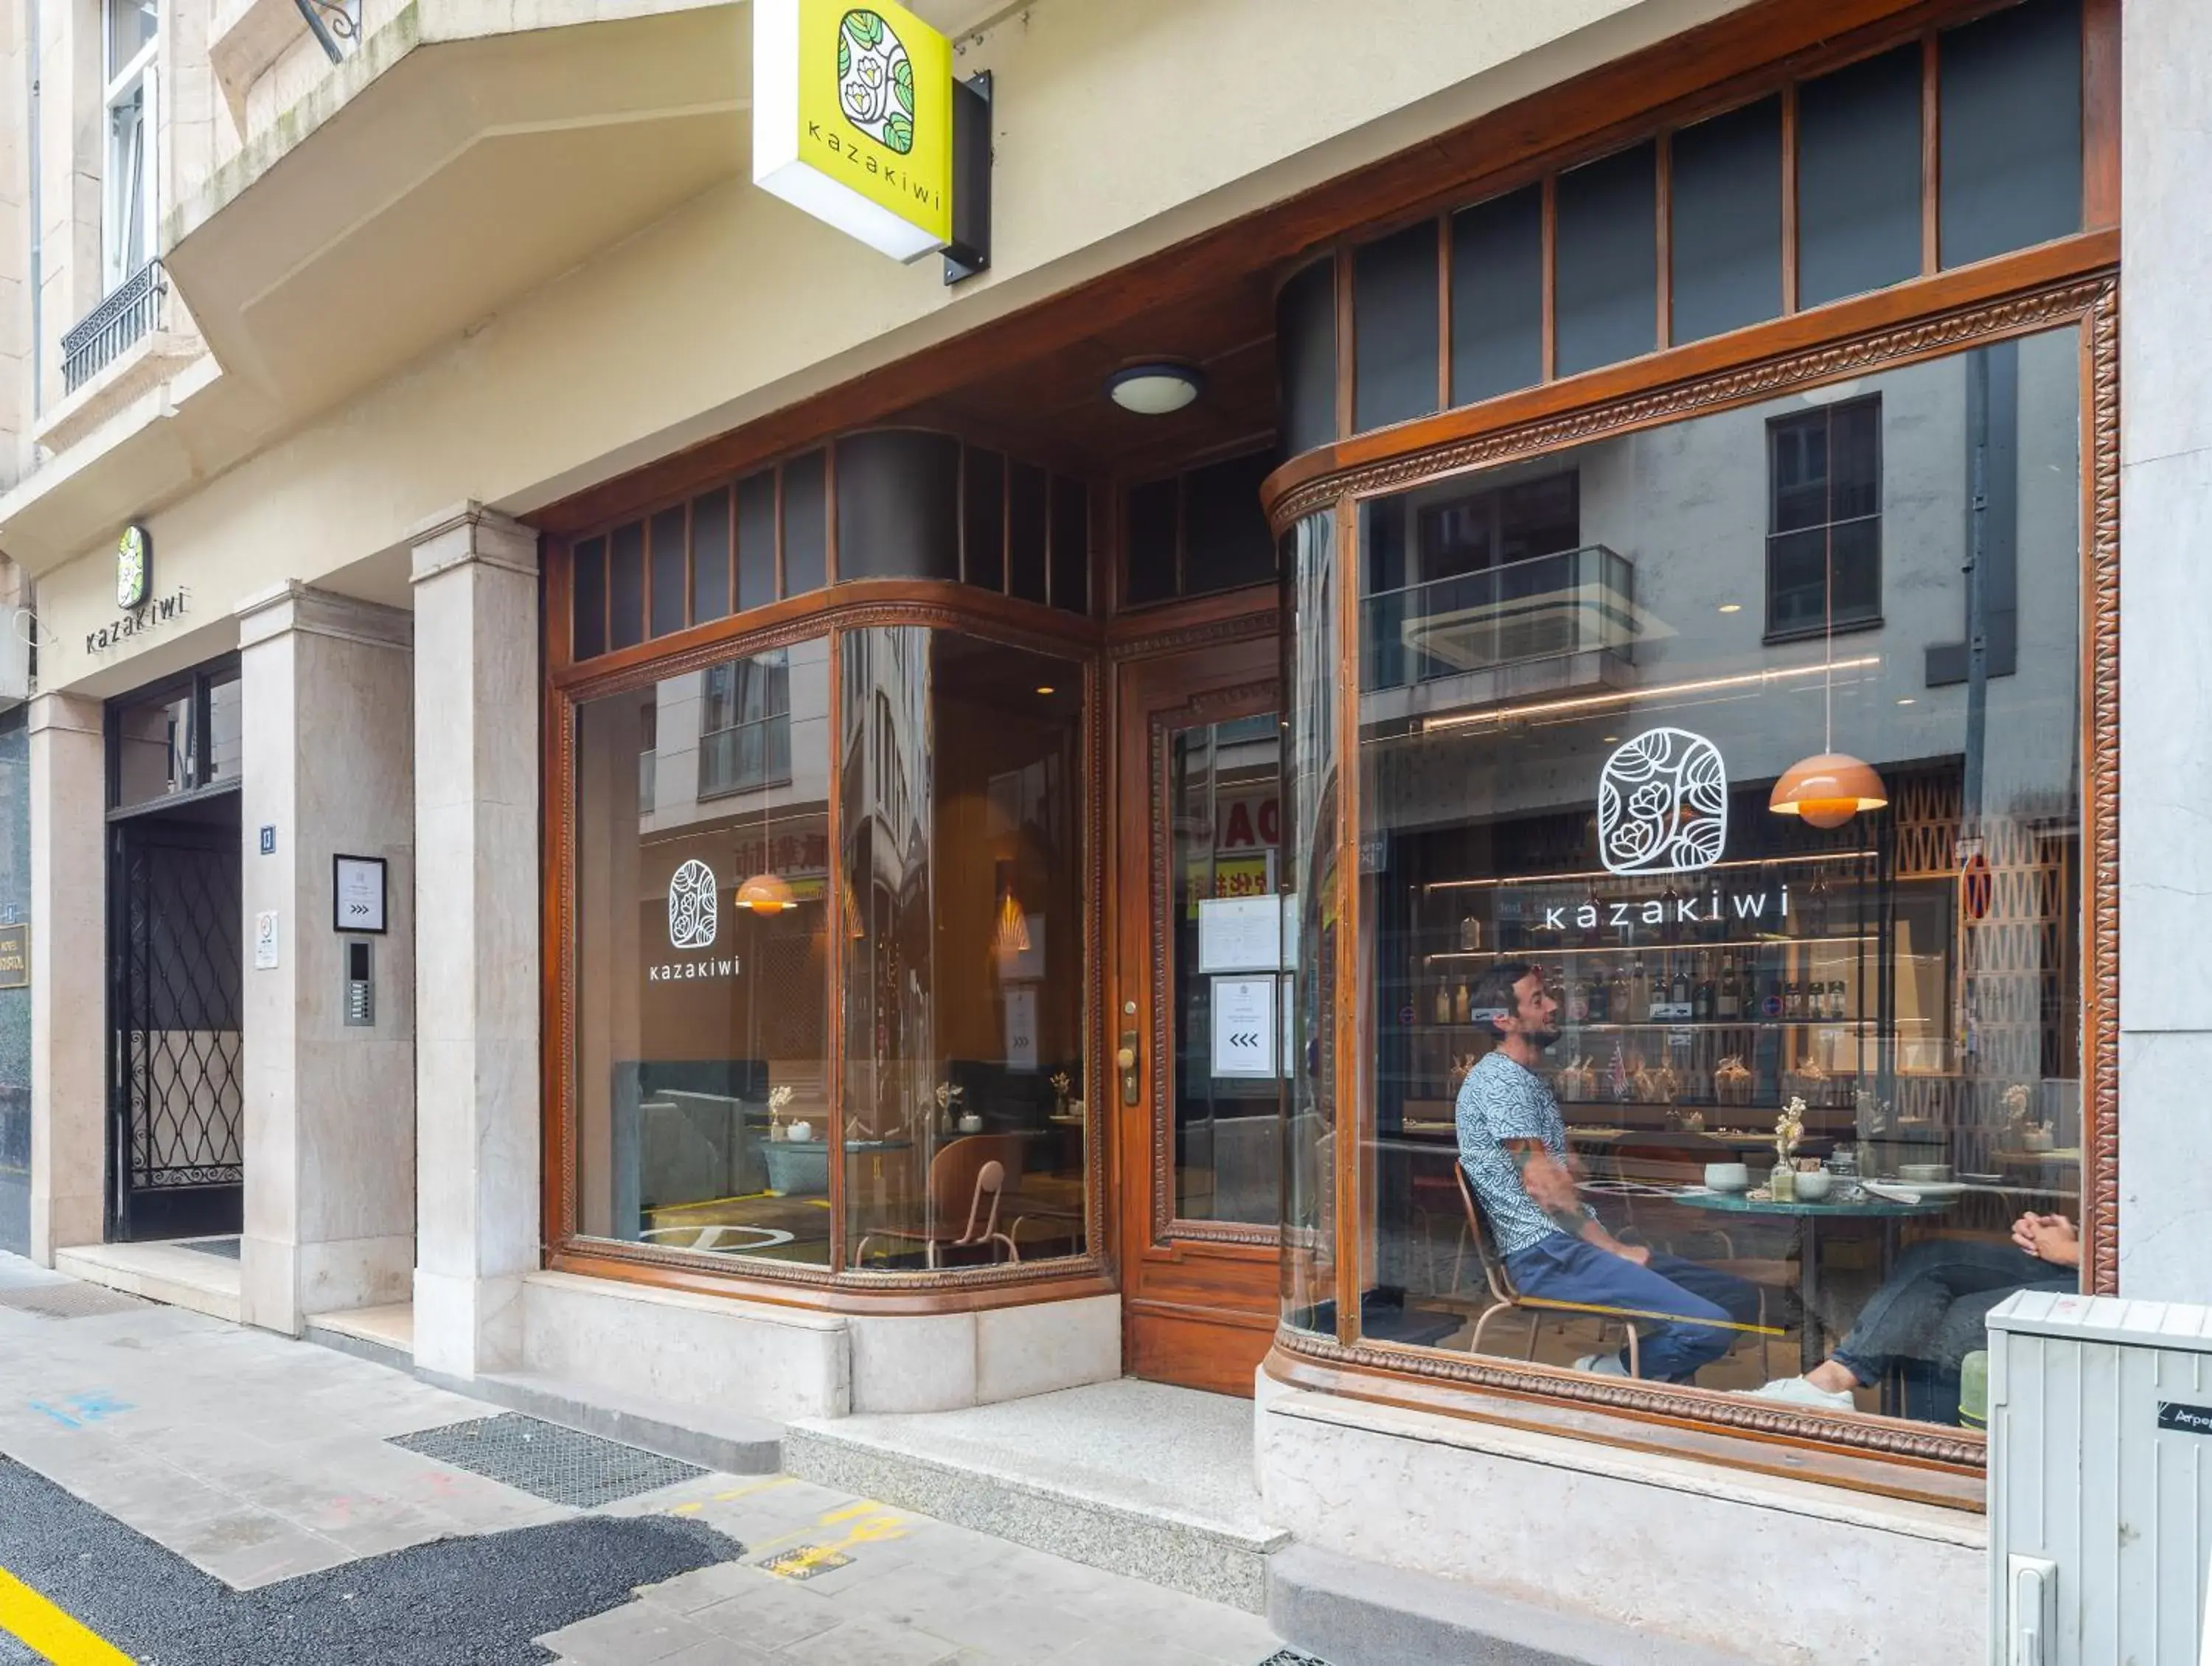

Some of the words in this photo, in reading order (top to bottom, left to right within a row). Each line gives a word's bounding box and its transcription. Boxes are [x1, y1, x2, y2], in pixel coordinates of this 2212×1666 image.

[808, 120, 939, 211] kazakiwi
[86, 585, 184, 654] kazakiwi
[1545, 885, 1789, 930] kazakiwi
[650, 955, 740, 981] kazakiwi
